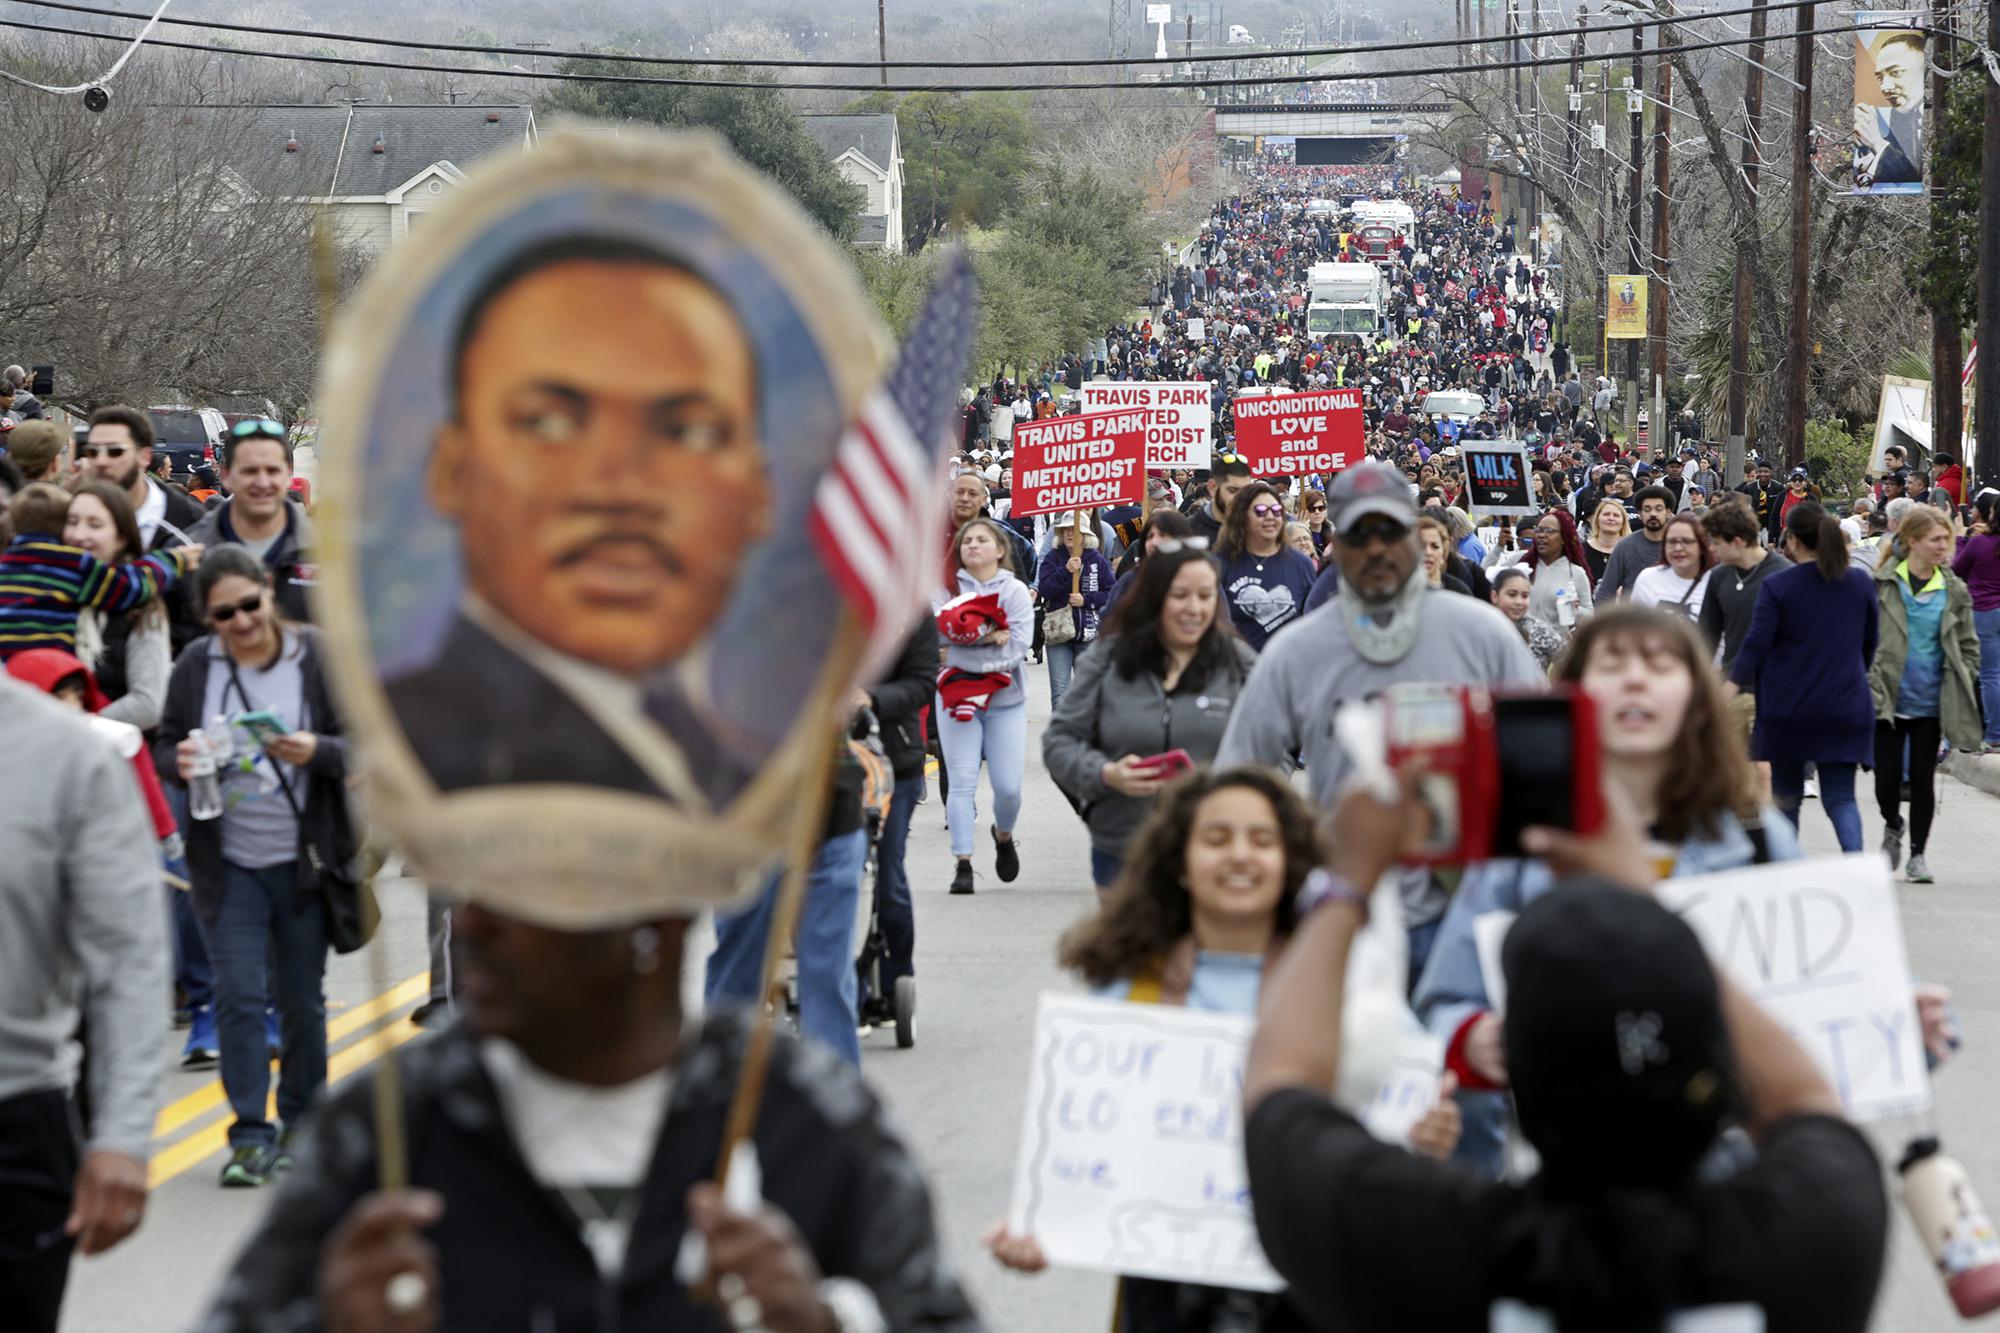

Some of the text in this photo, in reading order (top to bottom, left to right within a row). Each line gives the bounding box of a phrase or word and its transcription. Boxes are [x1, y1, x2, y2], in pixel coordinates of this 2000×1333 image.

[1085, 389, 1209, 405] TRAVIS PARK
[1237, 393, 1359, 418] UNCONDITIONAL
[1146, 409, 1180, 424] TED
[1017, 413, 1145, 448] TRAVIS PARK
[1147, 428, 1205, 443] ODIST
[1044, 439, 1115, 465] UNITED
[1147, 446, 1187, 462] RCH
[1281, 435, 1318, 452] and
[1022, 458, 1136, 489] METHODIST
[1252, 452, 1346, 475] JUSTICE
[1474, 454, 1518, 480] MLK
[1037, 481, 1120, 508] CHURCH
[1684, 886, 1855, 982] ND
